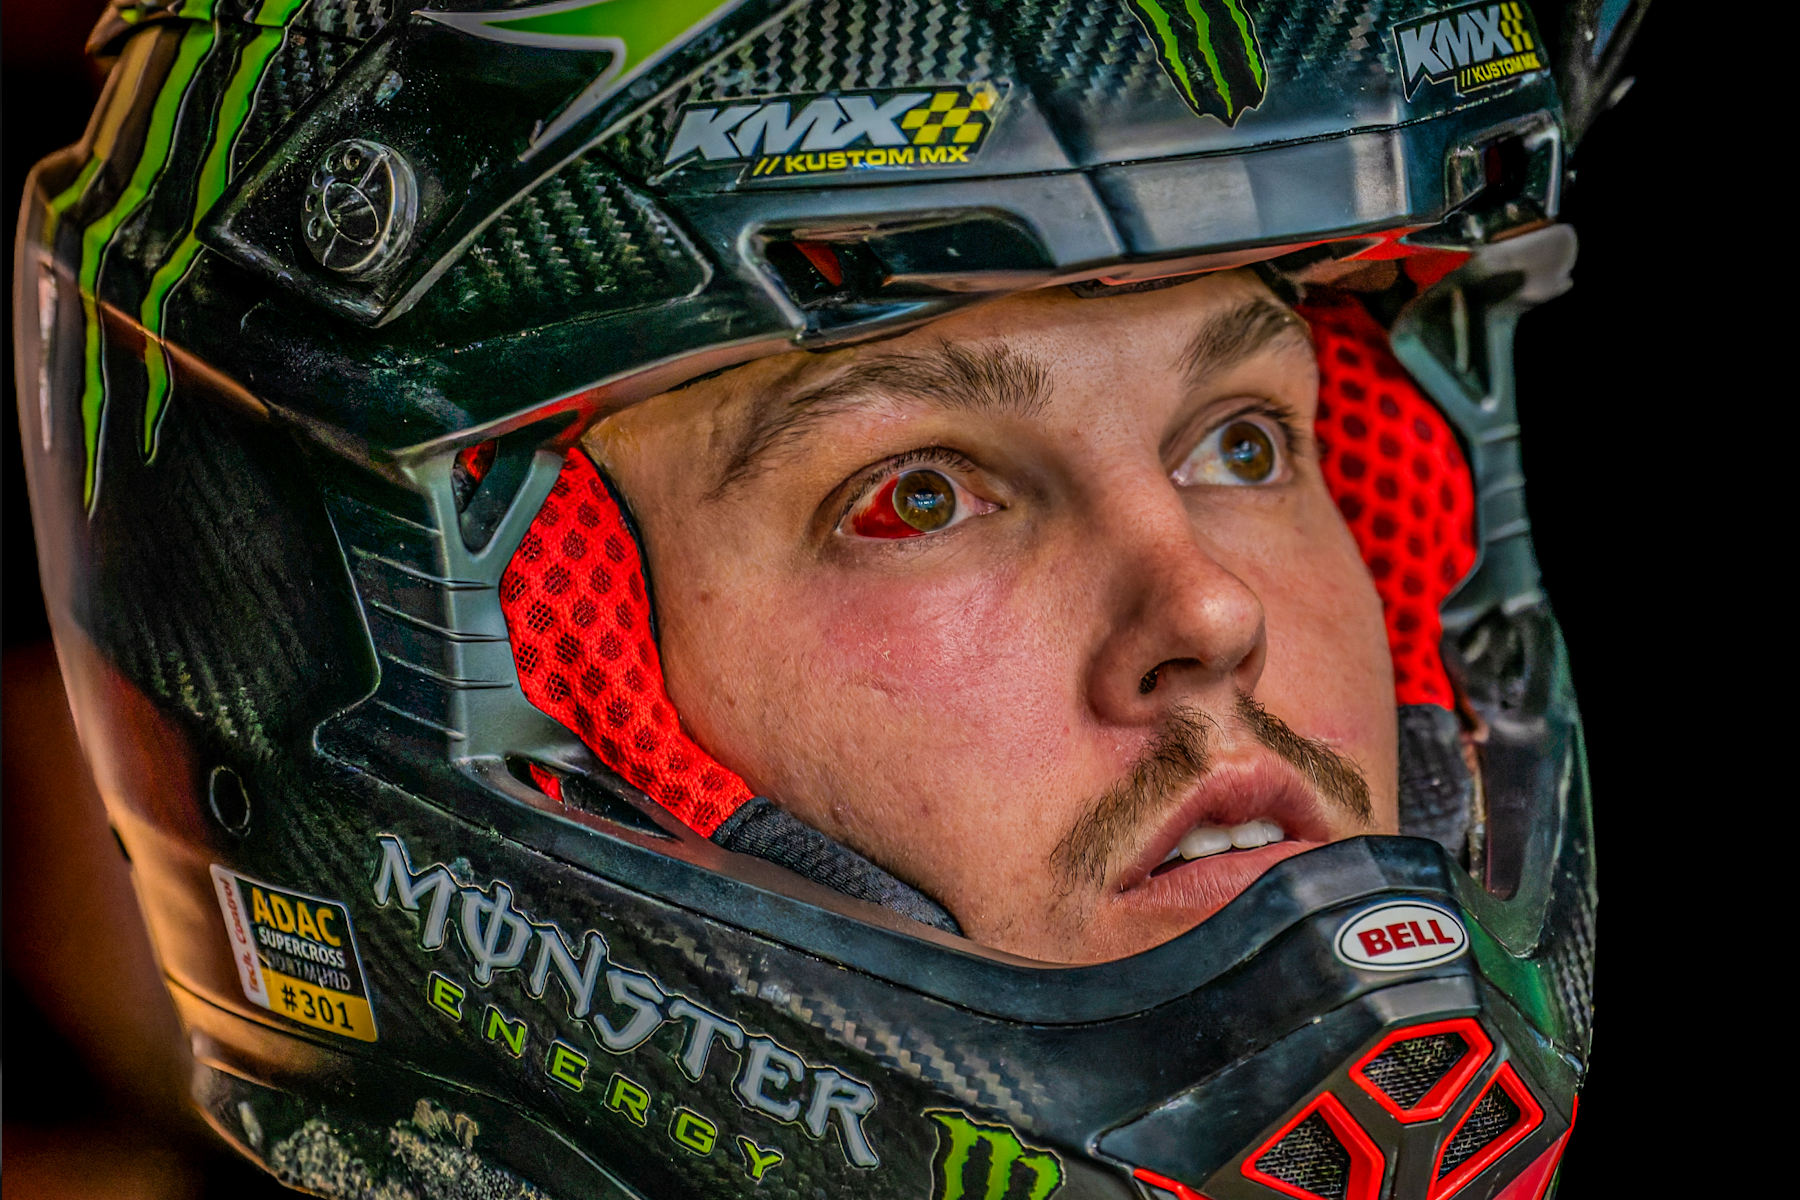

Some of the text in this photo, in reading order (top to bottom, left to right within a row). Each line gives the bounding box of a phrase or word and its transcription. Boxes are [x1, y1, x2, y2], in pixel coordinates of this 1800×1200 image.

[1399, 5, 1514, 83] KMX
[663, 92, 933, 165] KMX
[919, 145, 970, 163] MX
[252, 887, 342, 947] ADAC
[1356, 919, 1456, 958] BELL
[257, 926, 346, 970] SUPERCROSS
[280, 983, 354, 1031] #301
[374, 838, 879, 1169] MONSTER
[432, 976, 783, 1180] ENERGY
